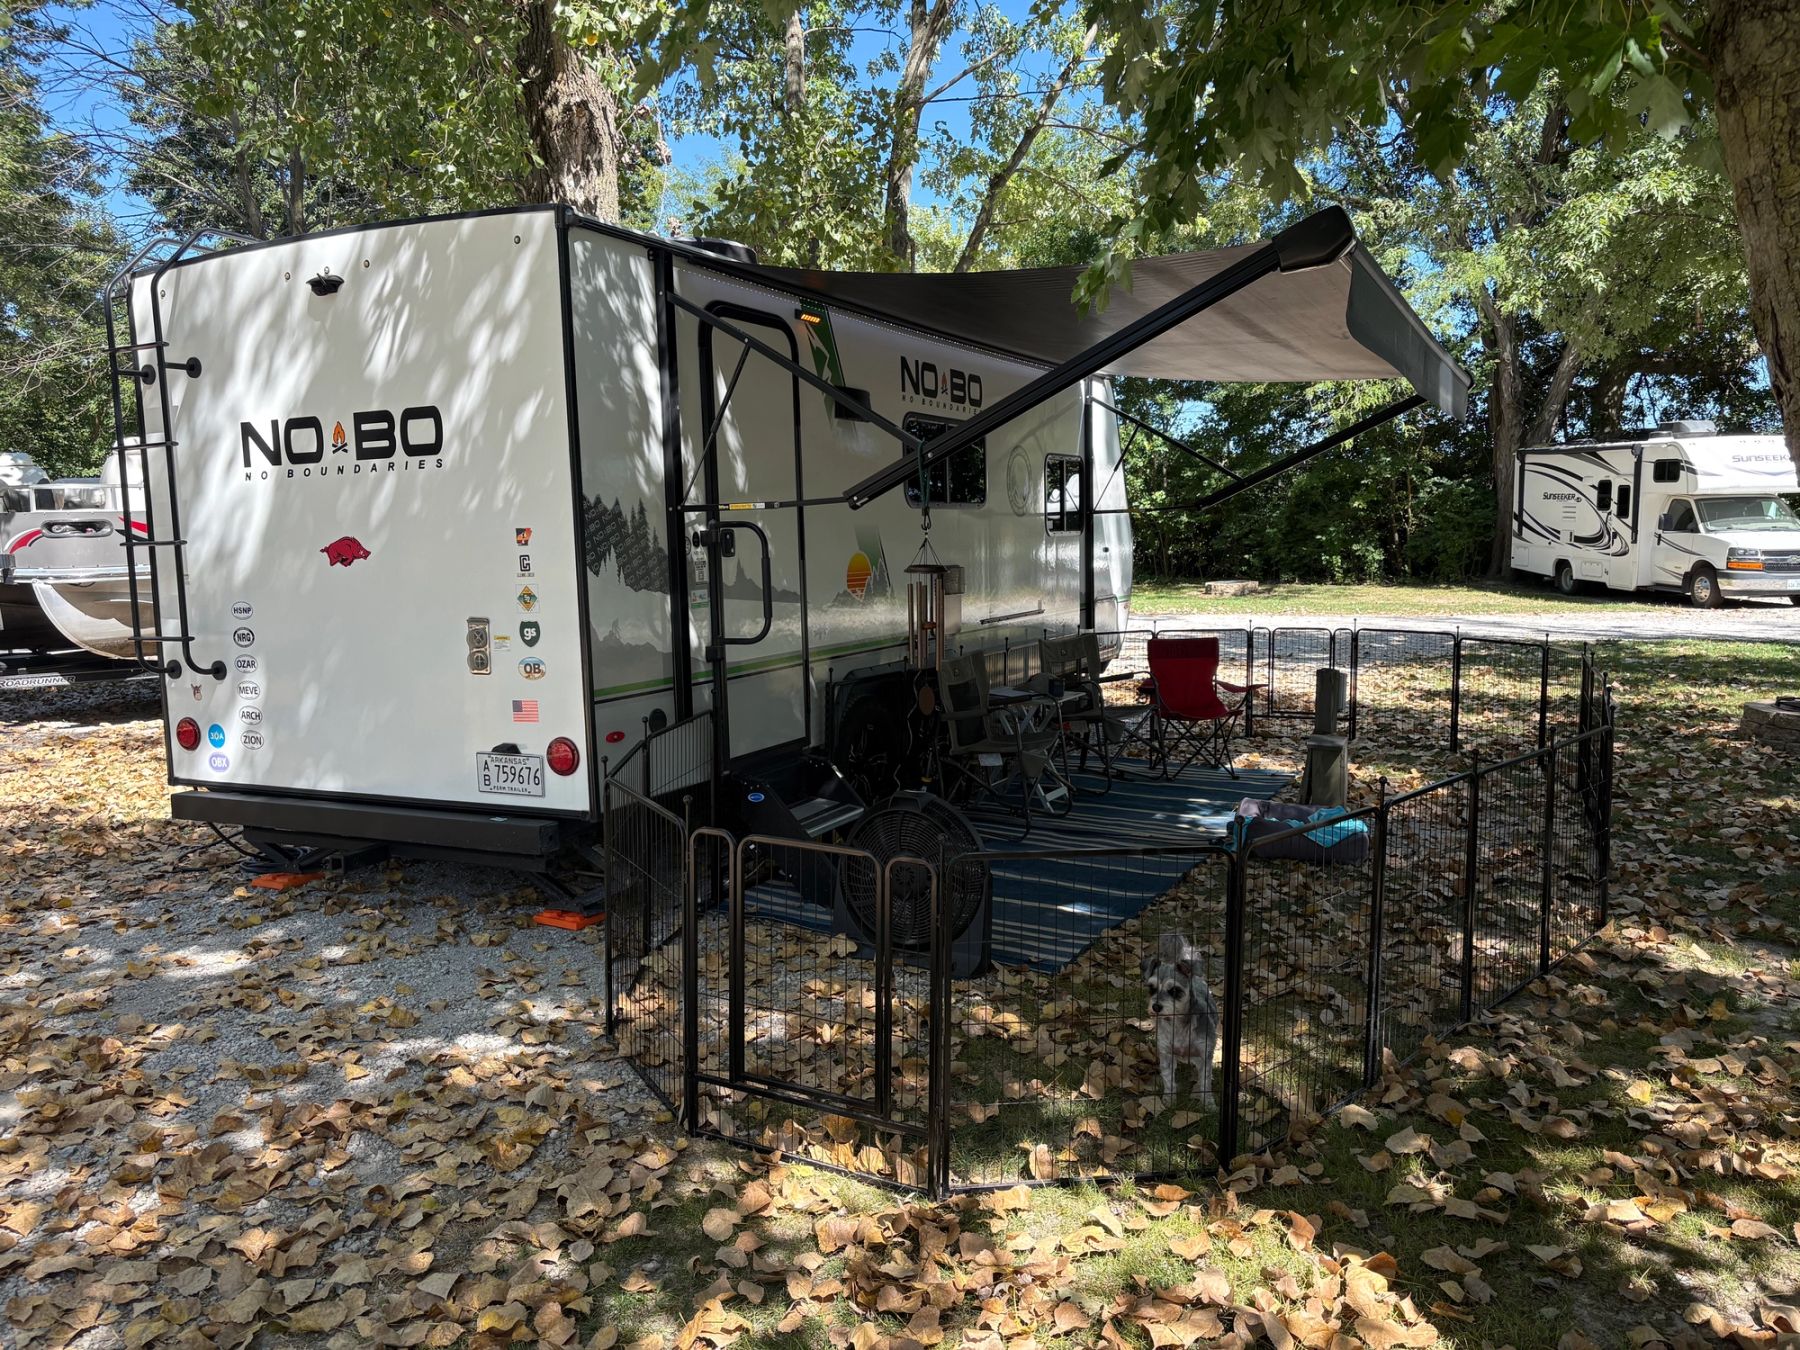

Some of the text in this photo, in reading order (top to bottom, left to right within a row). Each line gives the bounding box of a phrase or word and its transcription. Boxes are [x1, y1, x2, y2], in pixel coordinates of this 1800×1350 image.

[901, 356, 982, 408] NO BO
[922, 398, 982, 415] BOUNDARIE
[240, 405, 443, 468] NO BO
[1732, 454, 1790, 462] SUNSEEK
[245, 458, 443, 481] NO BOUNDARIES
[237, 633, 251, 642] NRG
[523, 628, 537, 640] gs
[236, 660, 256, 669] OZAR
[239, 686, 258, 695] MEVE
[241, 711, 261, 720] ARCH
[243, 735, 262, 745] ZION
[490, 757, 527, 766] ARKANSAS
[494, 764, 541, 786] 759676
